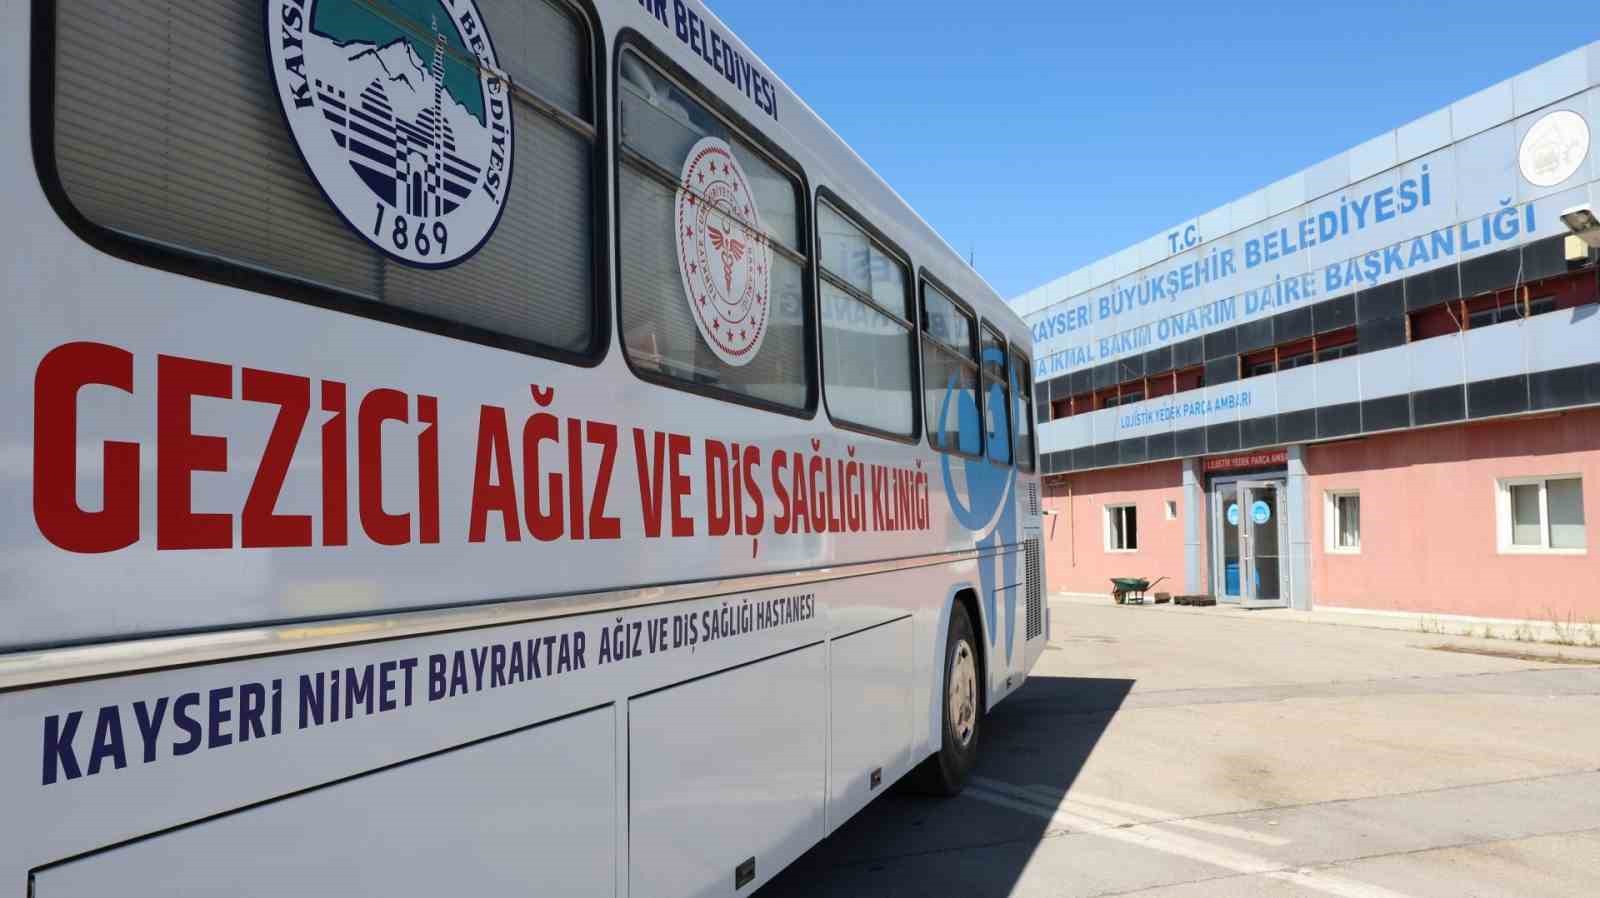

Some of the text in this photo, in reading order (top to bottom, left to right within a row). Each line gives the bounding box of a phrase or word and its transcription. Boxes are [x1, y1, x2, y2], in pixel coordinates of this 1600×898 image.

[282, 0, 314, 110] KAYS
[373, 202, 448, 256] 1869
[1099, 247, 1237, 321] BÜYÜKŞEHİR
[1244, 164, 1432, 268] BELEDİYESİ
[1100, 324, 1151, 358] BAKIM
[1157, 296, 1236, 341] ONARIM
[1244, 273, 1316, 316] DAİRE
[1325, 198, 1537, 292] BAŞKANLIĞI
[1168, 224, 1202, 253] T.C.
[468, 384, 621, 543] AĞIZ
[633, 427, 695, 538] VE
[705, 439, 764, 559] DİŞ
[771, 438, 867, 534] SAĞLIĞI
[42, 593, 816, 785] KAYSERİ NİMET BAYRAKTAR AĞIZ VE DİŞ SAĞLIĞI HASTANESİ
